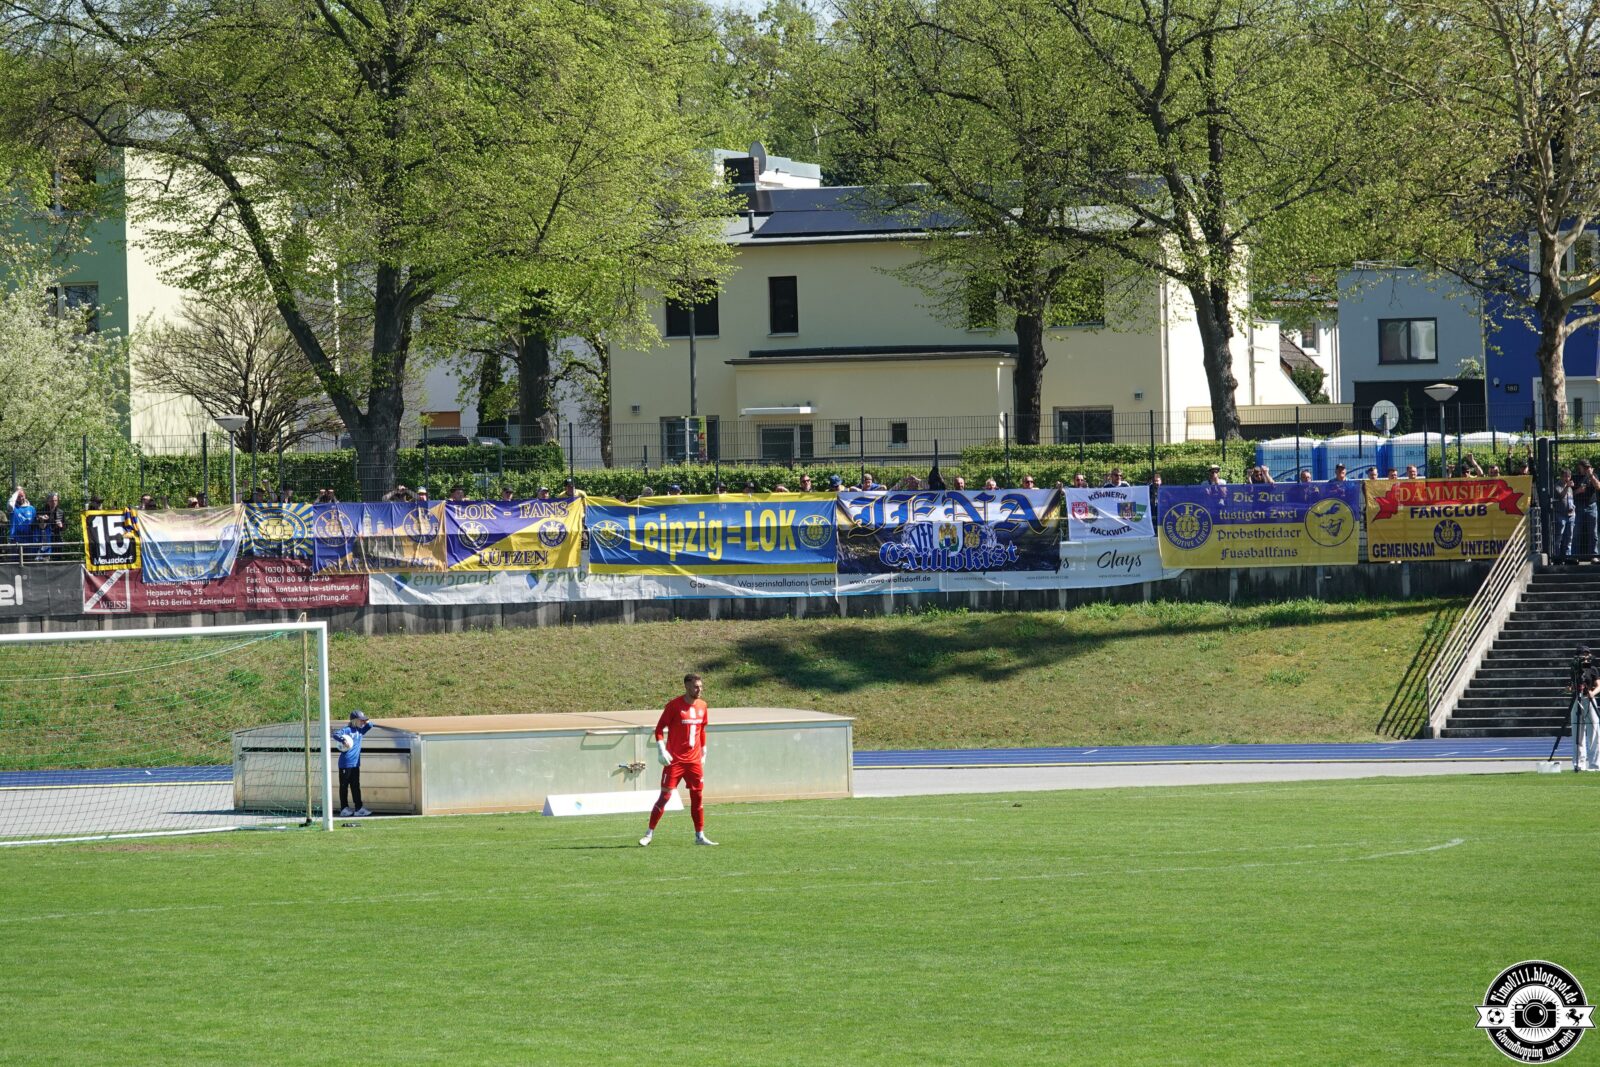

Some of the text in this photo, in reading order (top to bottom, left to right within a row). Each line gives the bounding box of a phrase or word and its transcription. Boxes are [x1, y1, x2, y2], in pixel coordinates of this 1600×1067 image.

[1088, 491, 1128, 501] KÖNNERN
[1233, 491, 1285, 503] Die Drei
[1400, 483, 1500, 502] DAMMSITZ
[455, 503, 497, 520] LOK
[519, 501, 569, 519] FANS
[848, 490, 1049, 538] JENA
[1219, 508, 1298, 522] lustigen Zwei
[1410, 504, 1488, 519] FANCLUB
[92, 515, 130, 557] 15
[627, 509, 723, 562] Leipzig
[745, 509, 797, 553] LOK
[1090, 525, 1133, 536] RACKWITZ
[1166, 520, 1209, 547] LOKOMOTIVE LEIPZIG
[478, 547, 549, 567] LÜTZEN
[1221, 545, 1298, 561] Fussballfans
[1372, 542, 1435, 558] GEMEINSAM
[1097, 549, 1142, 573] Clays
[246, 576, 260, 584] Fax:
[265, 575, 284, 583] (030)
[738, 578, 809, 589] Wasserinstallations
[811, 577, 836, 587] GmbH
[146, 589, 174, 598] Hegauer
[176, 588, 192, 597] Weg
[246, 586, 273, 594] E-Mail:
[147, 598, 169, 606] 14163
[171, 598, 191, 606] Berlin
[199, 597, 236, 605] Zehlendorf
[246, 595, 277, 603] Internet:
